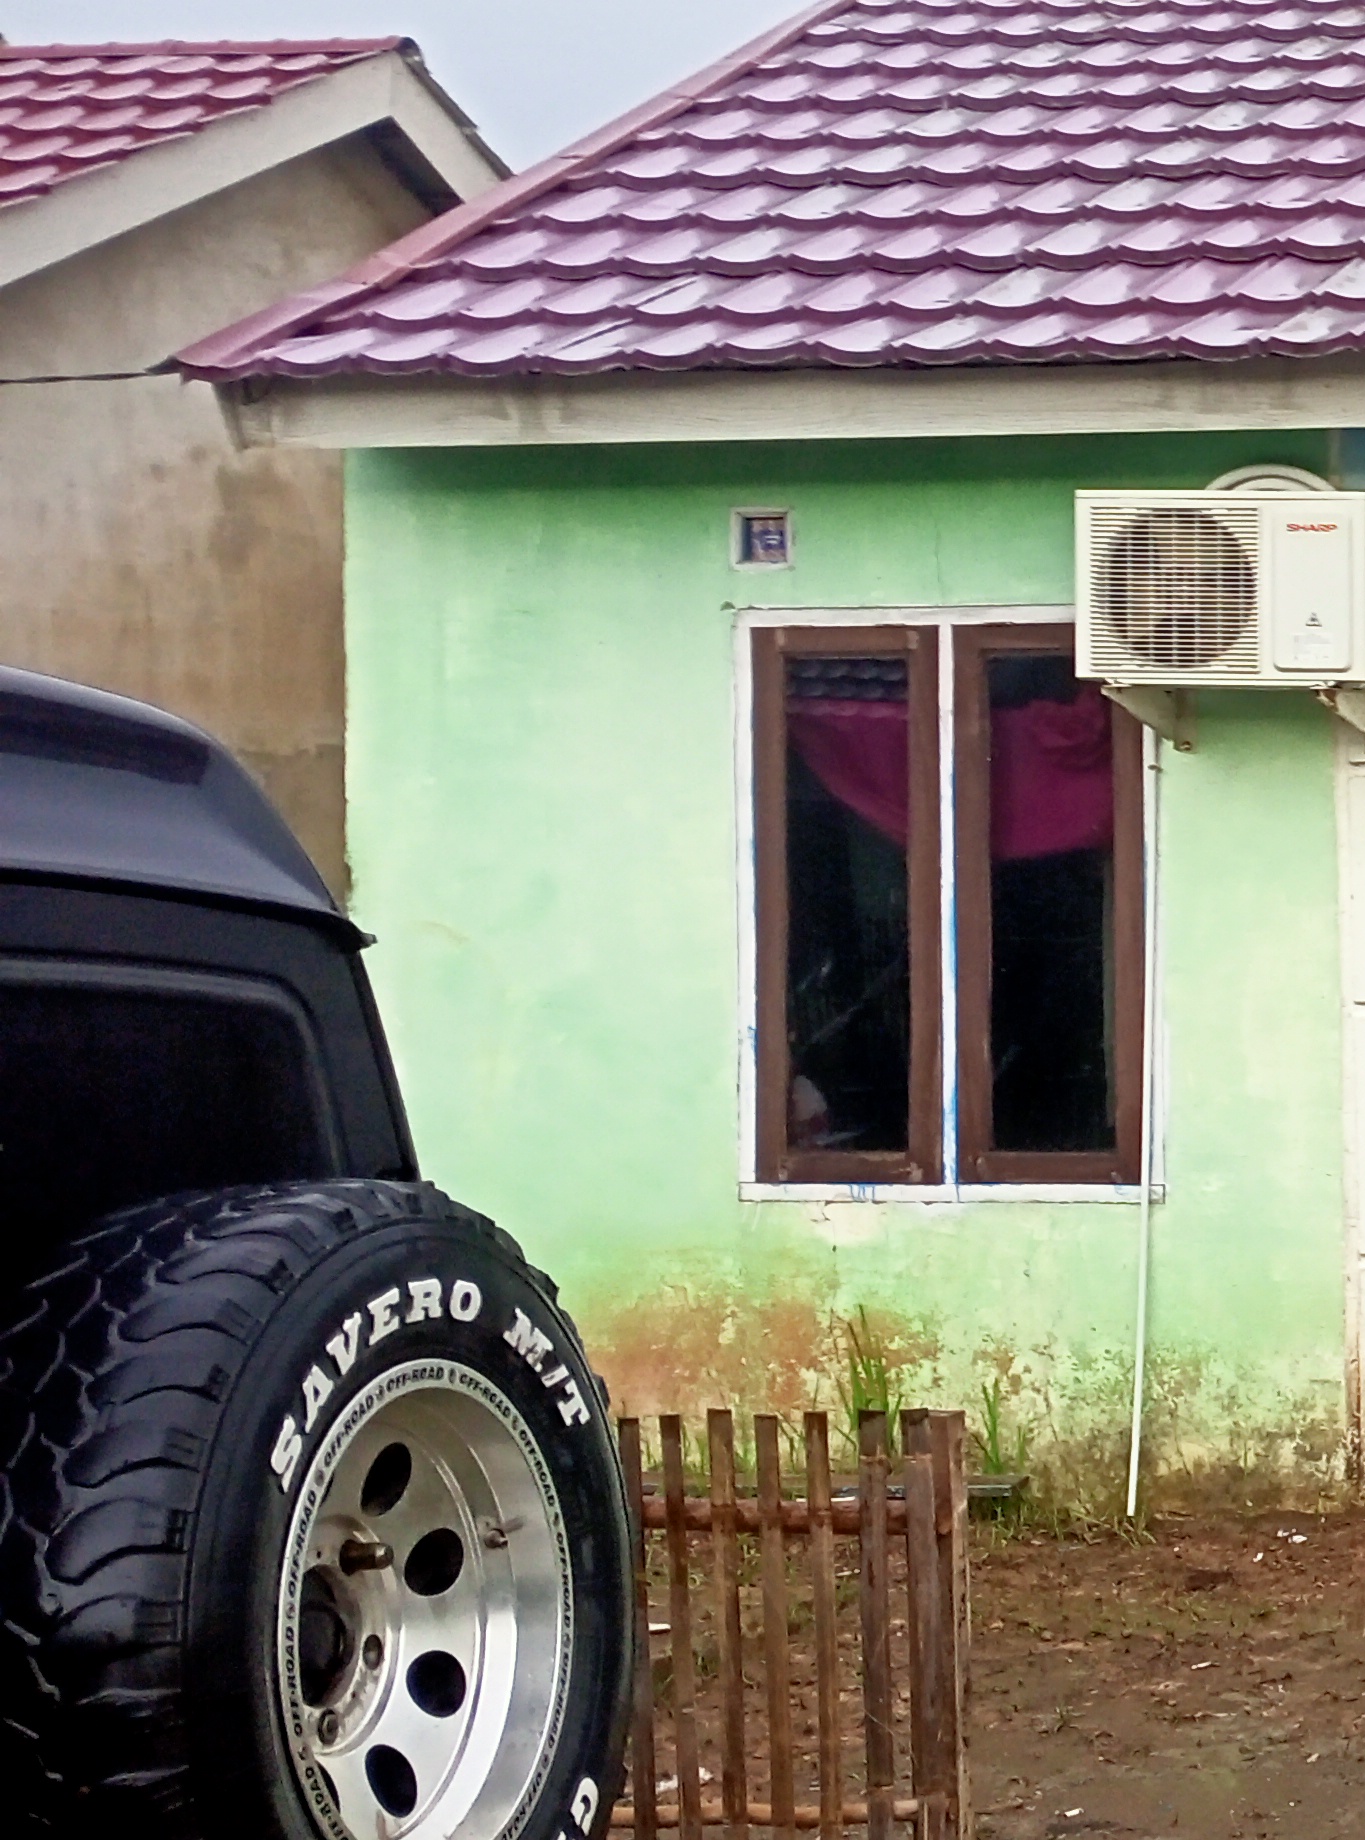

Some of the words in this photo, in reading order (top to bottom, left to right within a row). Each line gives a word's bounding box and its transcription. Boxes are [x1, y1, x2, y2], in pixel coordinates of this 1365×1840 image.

[1286, 523, 1338, 533] SHARP
[270, 1278, 483, 1493] SAVERO
[386, 1366, 446, 1393] OFF-ROAD
[459, 1373, 512, 1420] OFF-ROAD
[323, 1394, 375, 1468] OFF-ROAD
[517, 1429, 556, 1508] OFF-ROAD
[287, 1489, 317, 1599] OFF-ROAD
[556, 1531, 572, 1629] OFF-ROAD
[285, 1625, 304, 1738] OFF-ROAD
